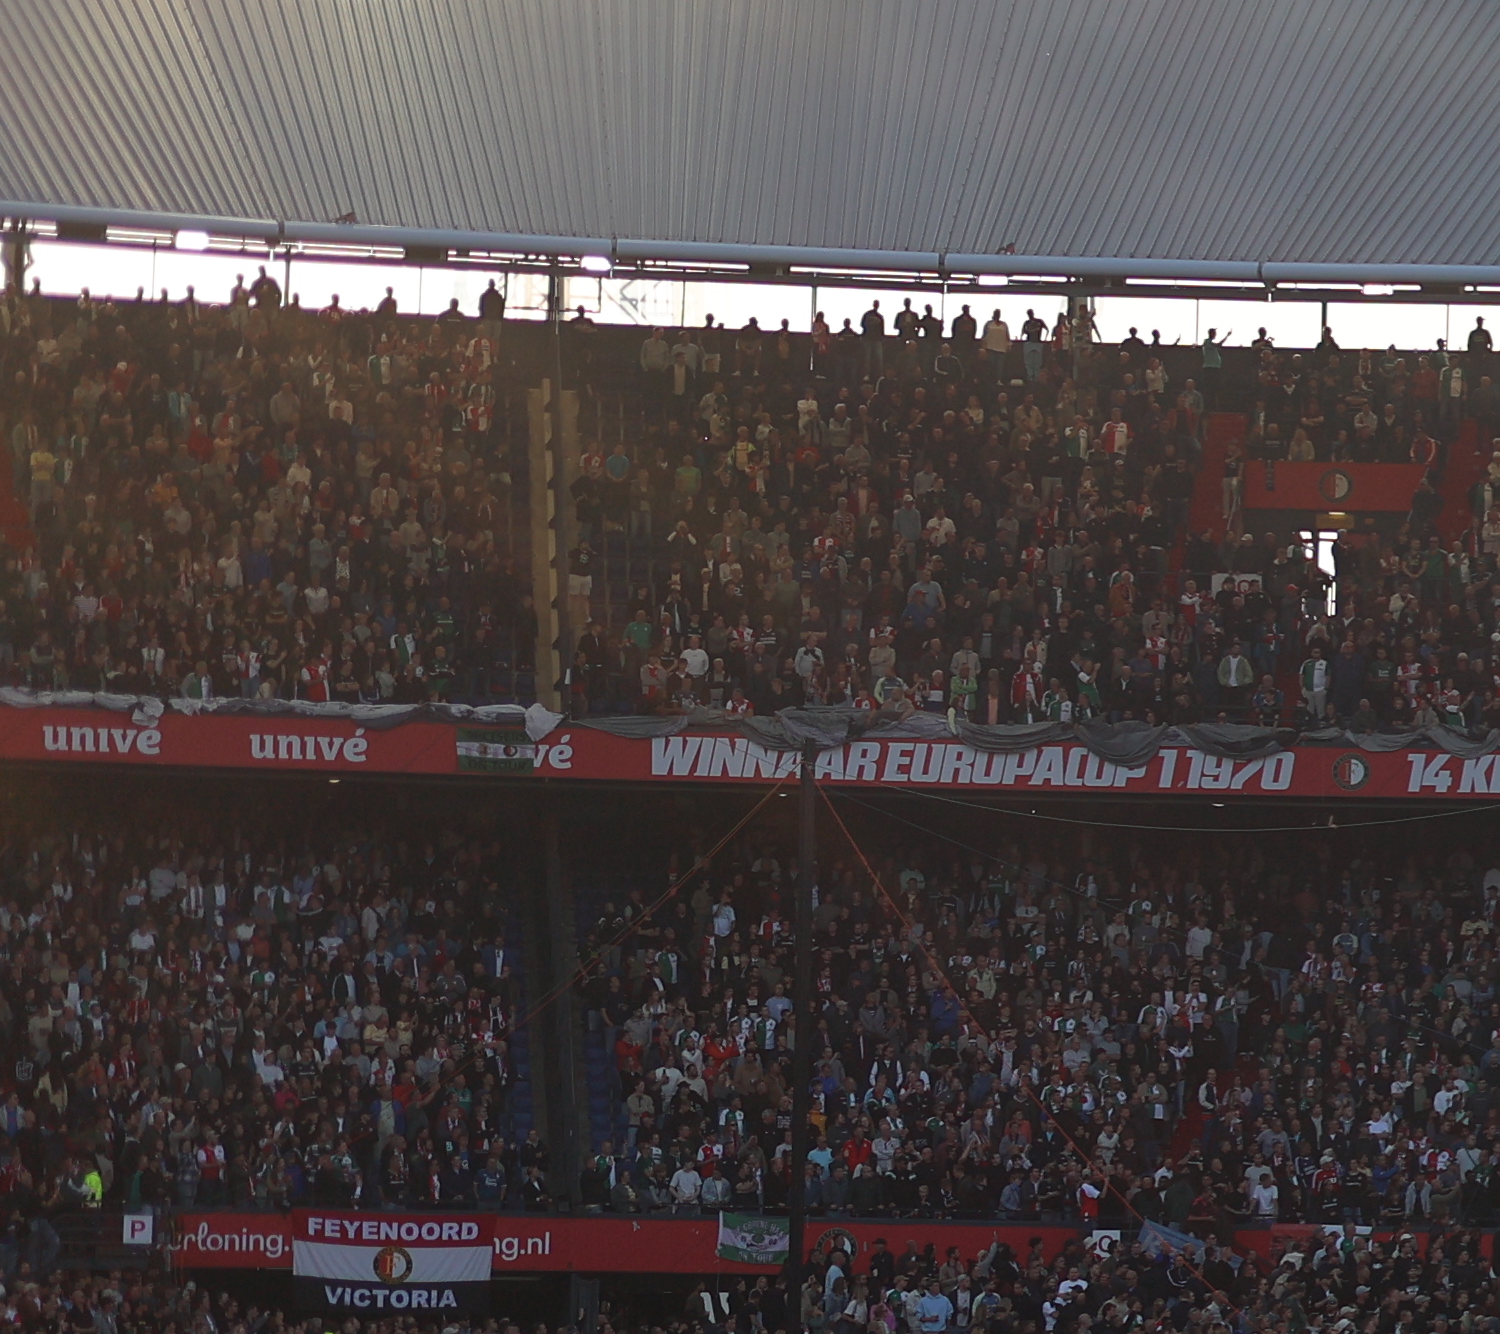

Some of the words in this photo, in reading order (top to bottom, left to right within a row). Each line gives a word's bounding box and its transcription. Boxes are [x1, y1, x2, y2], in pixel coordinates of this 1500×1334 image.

[651, 736, 882, 783] WINNAAR
[881, 742, 1147, 788] EUROPACUP
[1407, 753, 1453, 793] 14
[130, 1220, 146, 1240] P
[307, 1217, 480, 1243] FEYENOORD
[324, 1285, 458, 1310] VICTORIA
